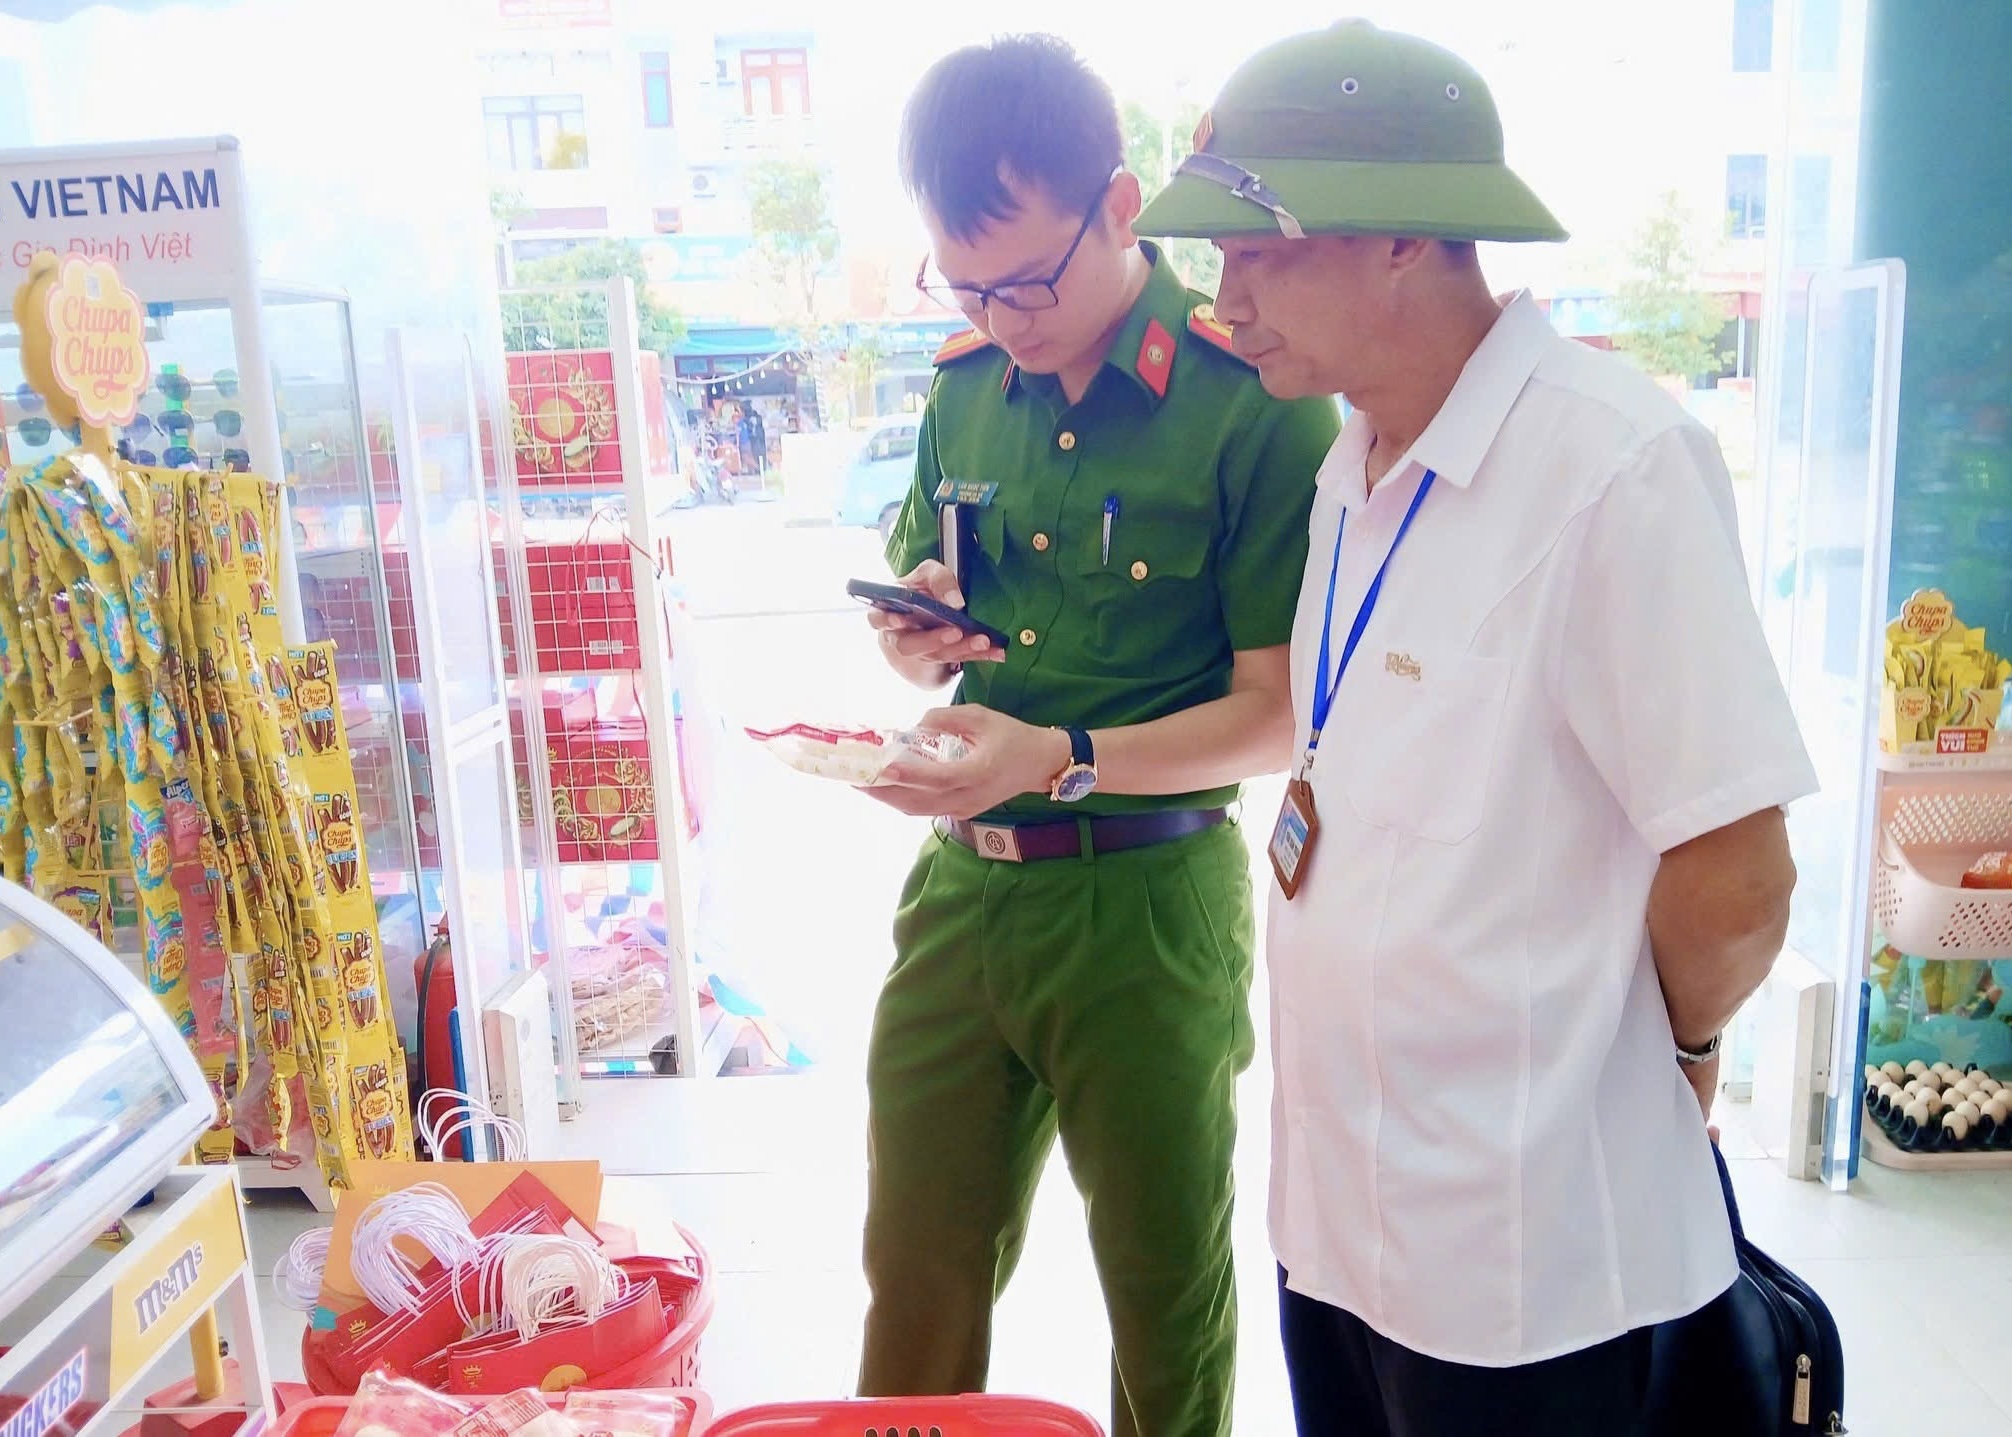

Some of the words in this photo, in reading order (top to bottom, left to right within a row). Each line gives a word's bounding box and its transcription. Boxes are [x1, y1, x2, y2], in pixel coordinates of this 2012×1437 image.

[11, 168, 220, 219] VIETNAM
[141, 232, 193, 264] Việt
[62, 296, 131, 343] Chupa
[64, 336, 133, 397] Chups
[1911, 604, 1947, 617] Chupa
[1907, 616, 1944, 635] Chups
[303, 687, 326, 698] Chupa
[302, 695, 326, 707] Chups
[1941, 739, 1965, 752] VUI
[327, 829, 351, 839] Chupa
[327, 837, 351, 848] Chups
